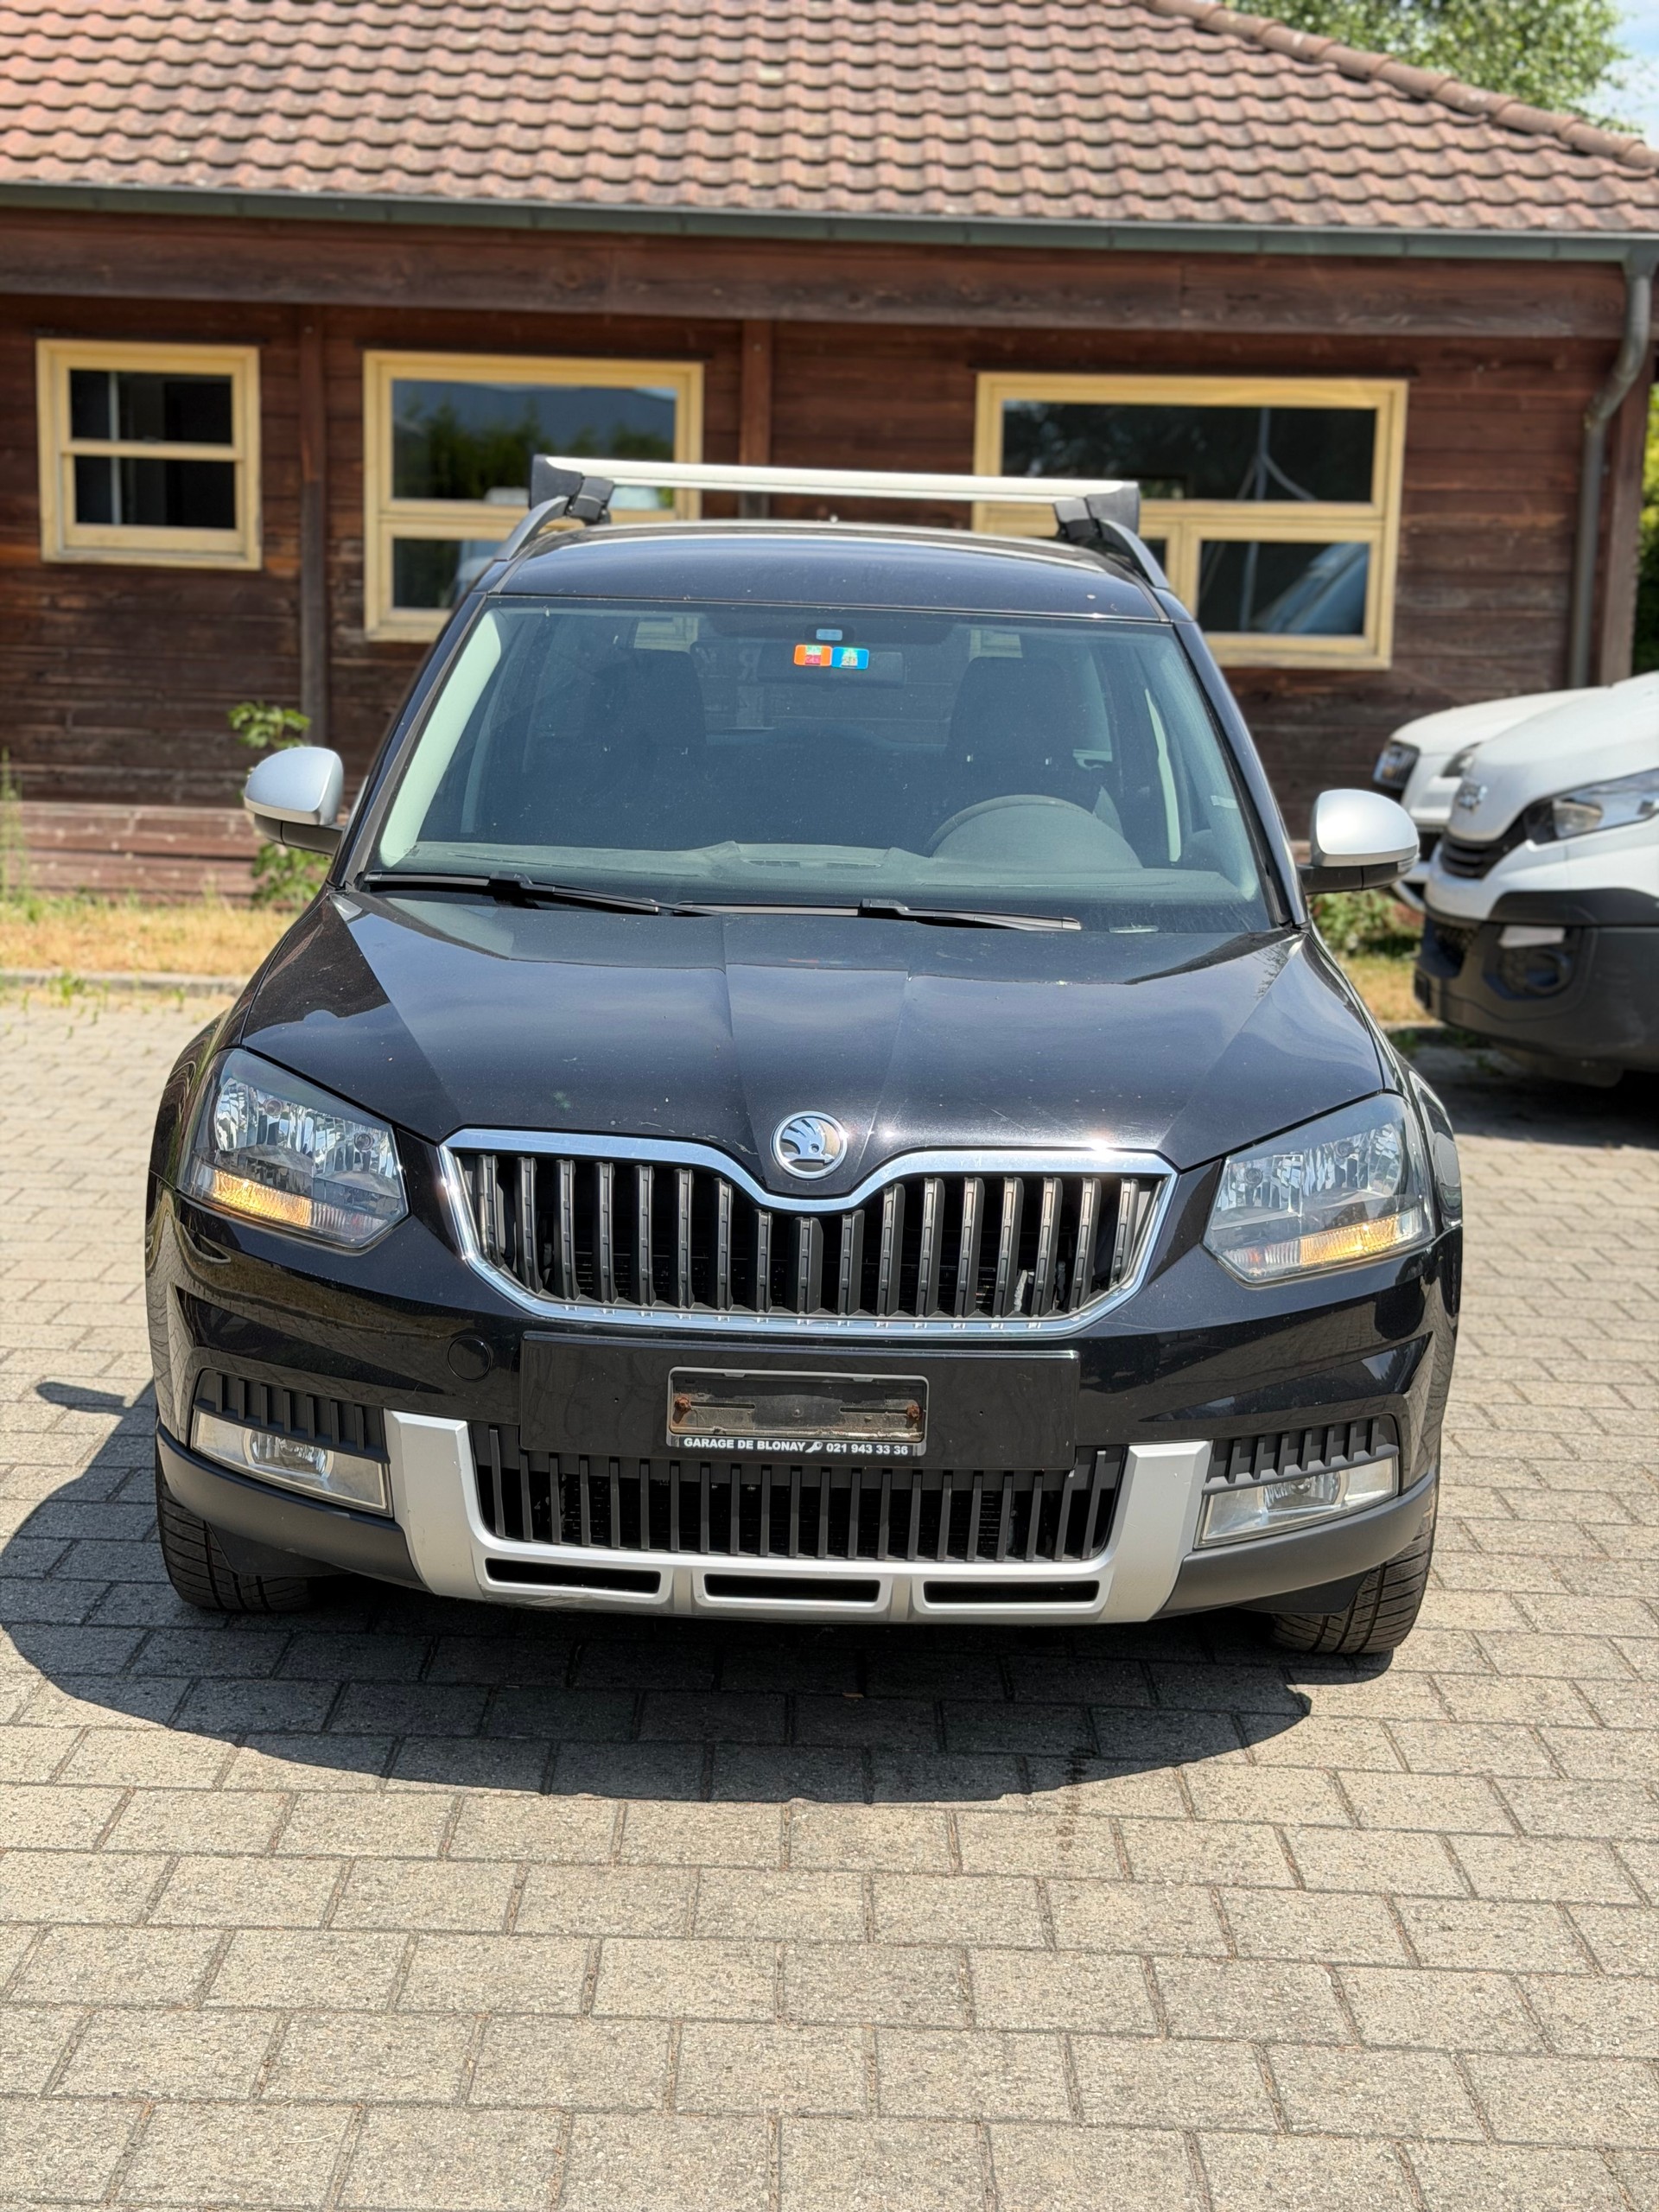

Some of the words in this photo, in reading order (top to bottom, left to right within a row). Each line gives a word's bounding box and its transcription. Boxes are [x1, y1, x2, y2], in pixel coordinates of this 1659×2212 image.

[683, 1438, 734, 1449] GARAGE
[737, 1440, 753, 1450] DE
[757, 1440, 805, 1452] BLONAY
[826, 1443, 847, 1452] 021
[851, 1444, 873, 1453] 943
[875, 1445, 891, 1454] 33
[893, 1445, 908, 1455] 36
